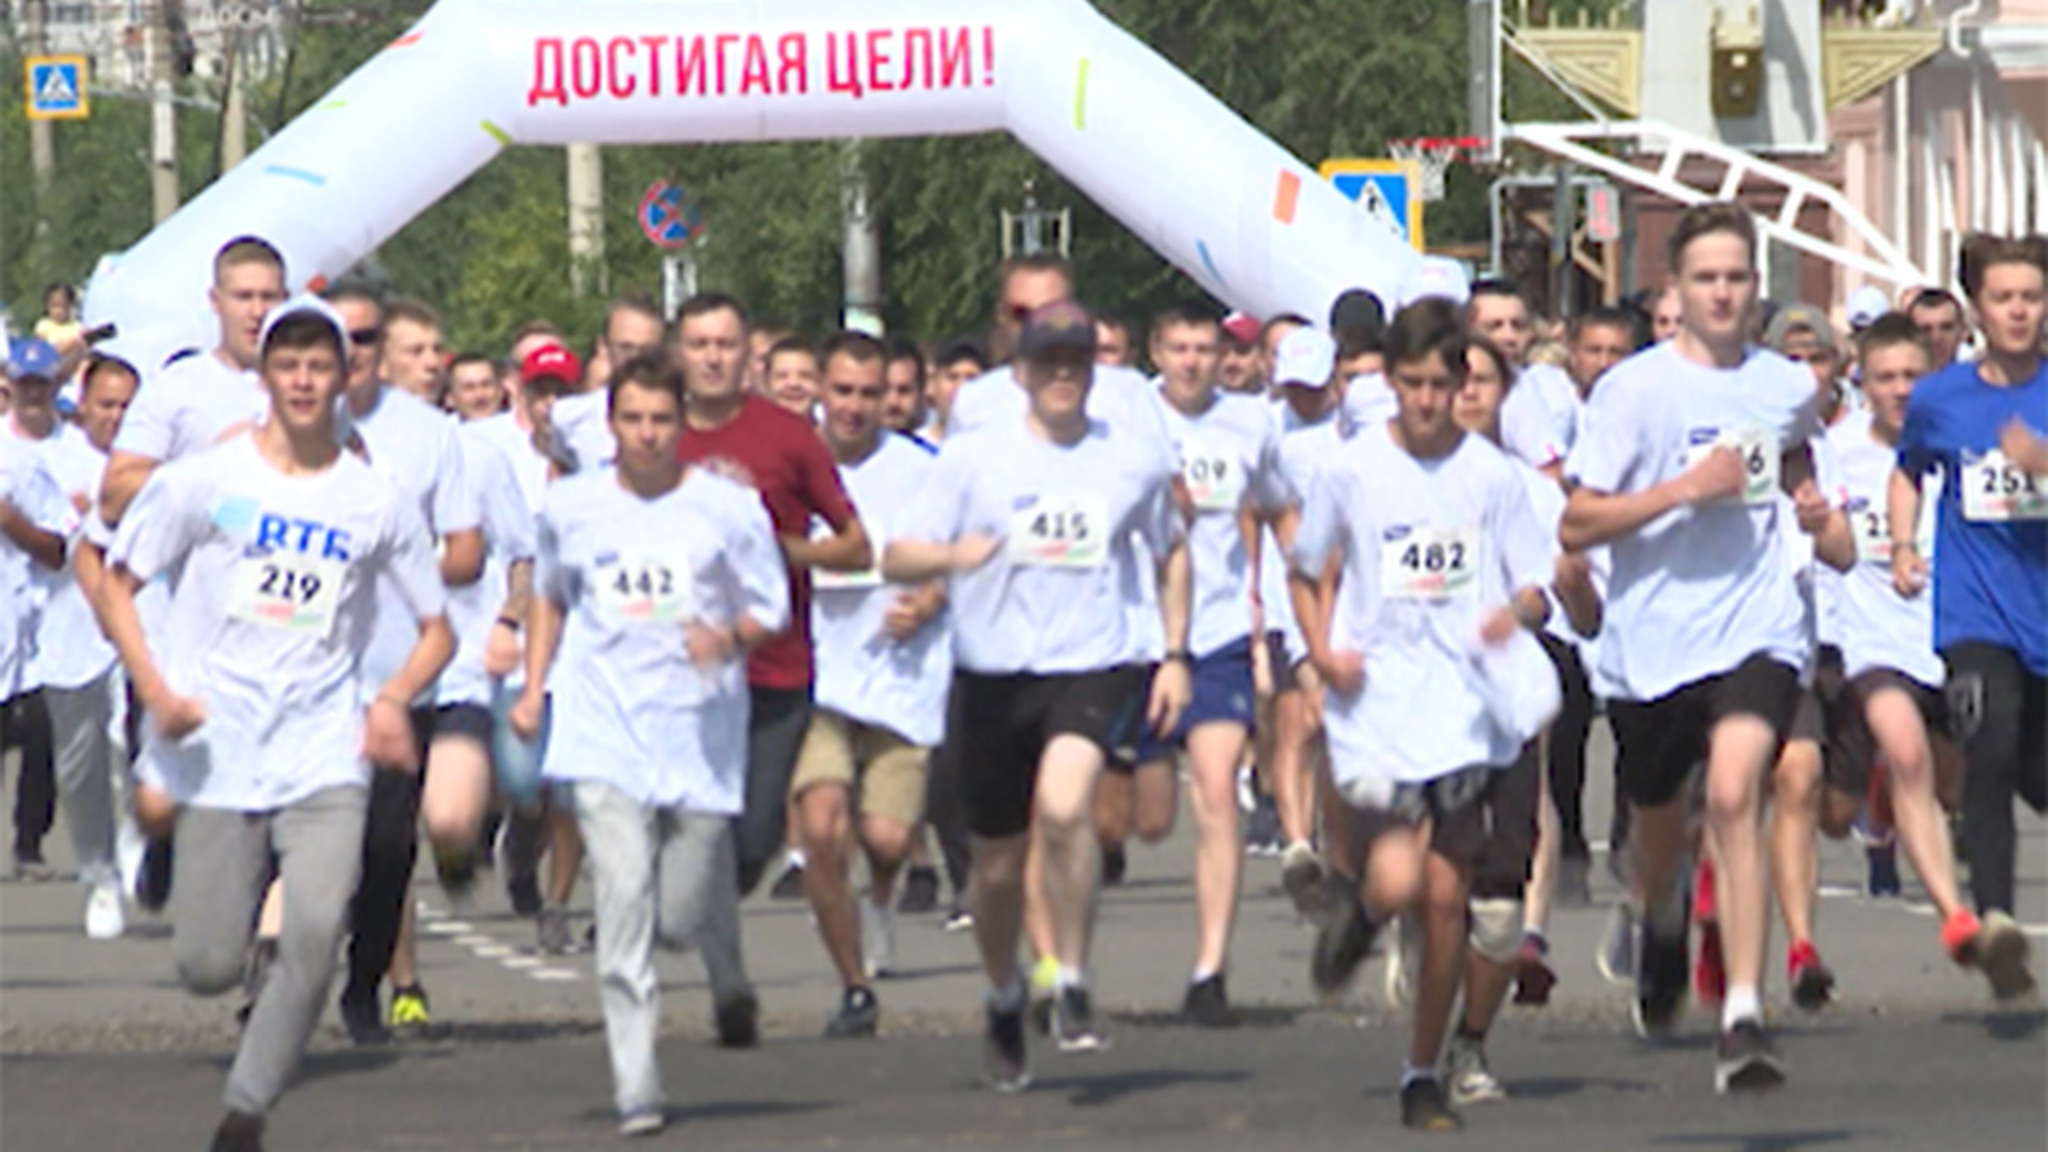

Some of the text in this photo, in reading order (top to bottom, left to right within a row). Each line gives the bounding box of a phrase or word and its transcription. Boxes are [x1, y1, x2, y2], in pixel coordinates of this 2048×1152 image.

[528, 26, 994, 106] ДОСТИГАЯ ЦЕЛИ!
[1180, 457, 1227, 481] 09
[1030, 512, 1087, 541] 415
[1401, 541, 1467, 572] 482
[259, 564, 321, 604] 219
[612, 568, 673, 595] 442
